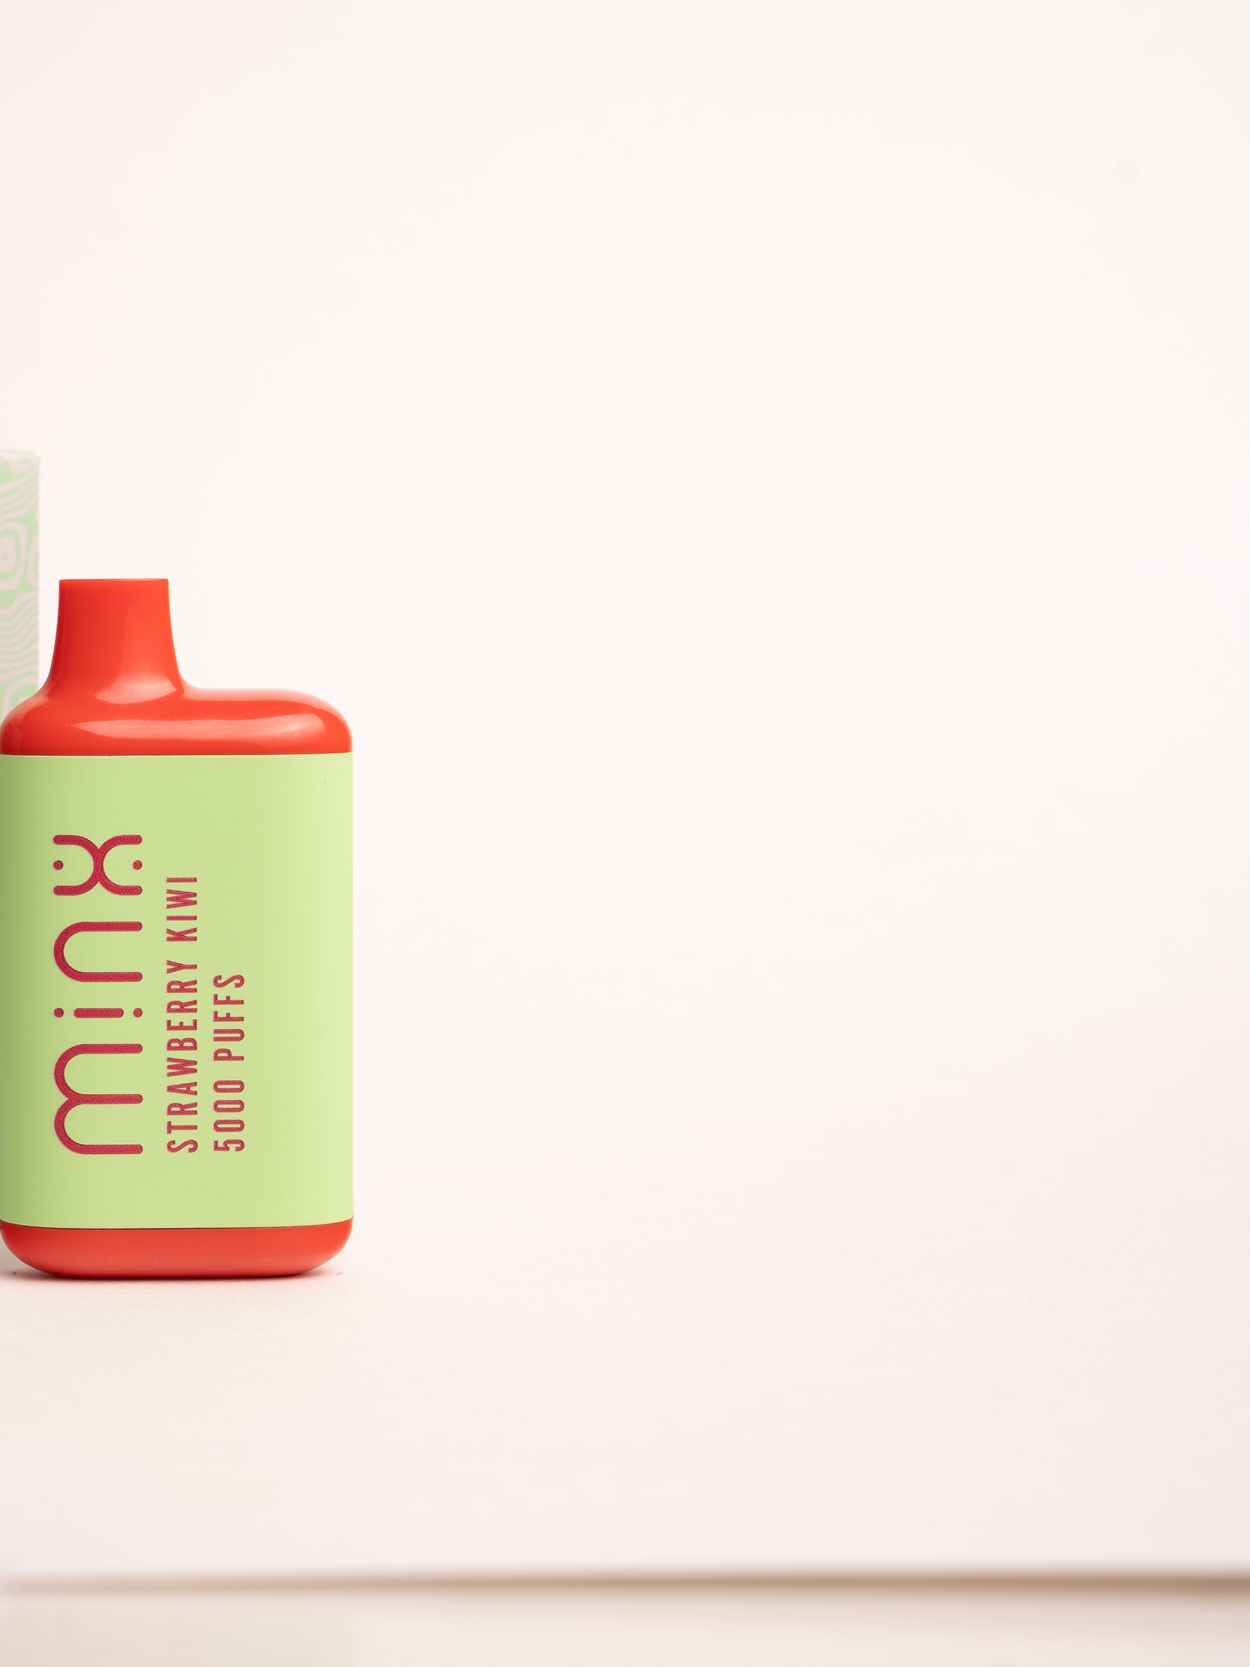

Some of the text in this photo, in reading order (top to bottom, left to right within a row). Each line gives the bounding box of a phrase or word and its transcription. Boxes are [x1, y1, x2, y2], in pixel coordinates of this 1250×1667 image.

[166, 876, 198, 1154] STRAWBERRY KIWI
[213, 973, 245, 1152] 5000 PUFFS
